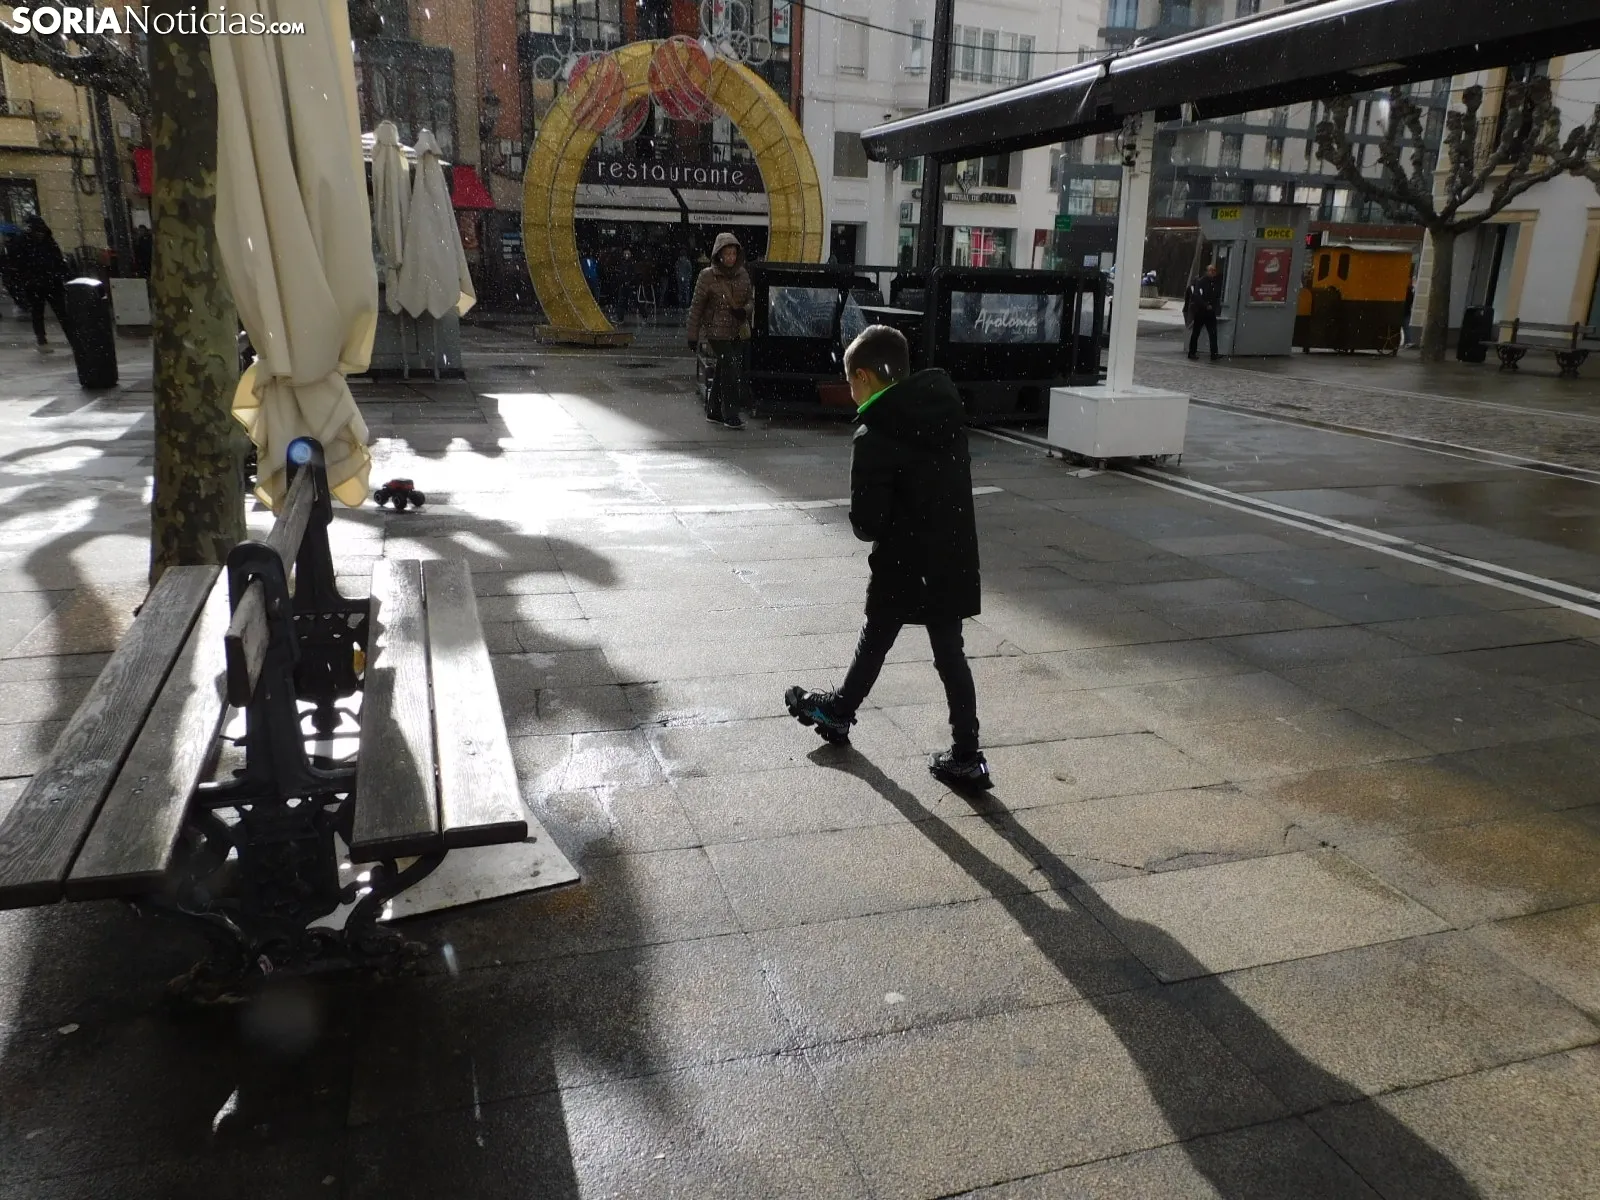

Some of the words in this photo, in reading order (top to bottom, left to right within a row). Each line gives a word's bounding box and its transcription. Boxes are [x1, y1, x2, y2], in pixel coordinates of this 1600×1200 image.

[598, 161, 744, 185] restaurante
[1219, 209, 1238, 218] ONCE
[1266, 229, 1291, 238] ONCE
[974, 307, 1037, 334] Apolonia
